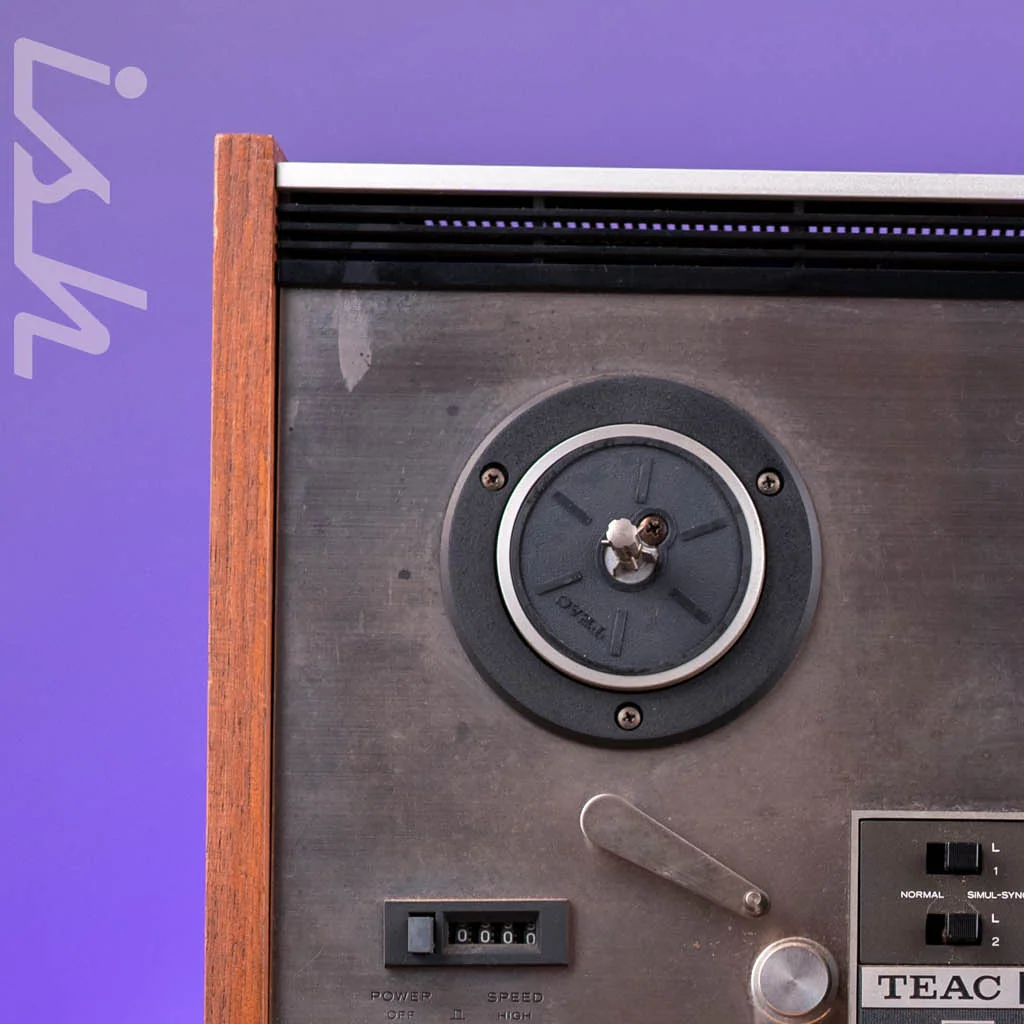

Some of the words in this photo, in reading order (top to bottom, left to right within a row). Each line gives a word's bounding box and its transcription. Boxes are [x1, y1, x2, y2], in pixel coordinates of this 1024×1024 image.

[991, 843, 1001, 852] L
[991, 914, 1000, 923] L
[991, 937, 1000, 946] 2
[877, 975, 1001, 1000] TEAC
[371, 991, 432, 1001] POWER
[487, 992, 544, 1003] SPEED
[387, 1010, 415, 1019] OFF
[497, 1011, 531, 1020] HIGH
